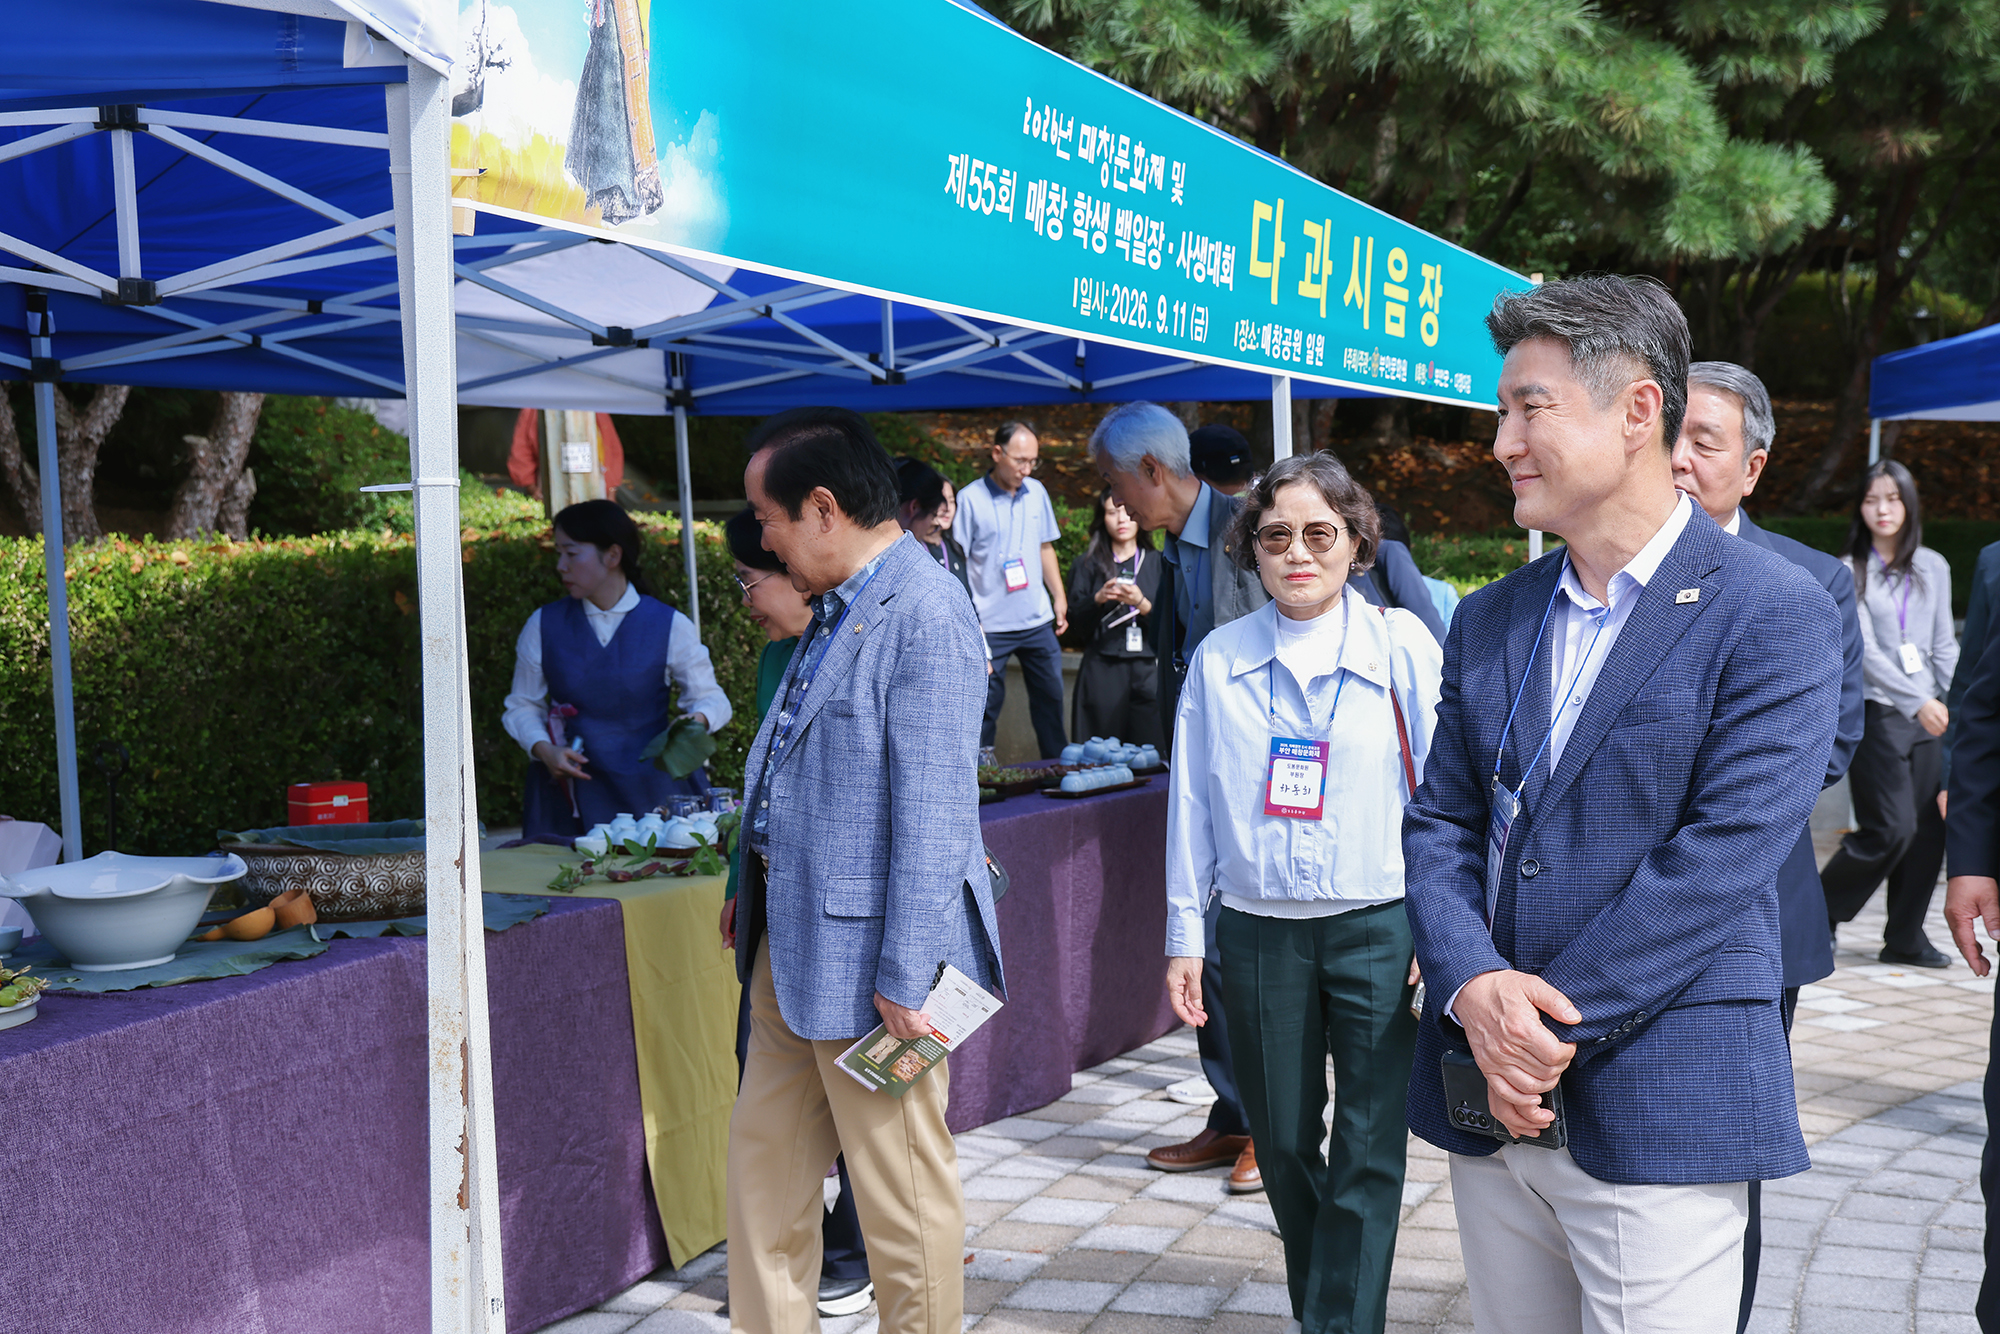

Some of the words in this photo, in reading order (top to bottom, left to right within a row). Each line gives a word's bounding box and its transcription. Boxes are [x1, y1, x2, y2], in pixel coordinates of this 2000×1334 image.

[1023, 96, 1075, 161] 2026년
[1078, 123, 1165, 194] 매창문화제
[1170, 160, 1186, 206] 및
[944, 153, 1018, 223] 제55회
[1024, 179, 1068, 241] 매창
[1072, 191, 1111, 255] 학생
[1305, 332, 1326, 367] 일원
[1279, 747, 1291, 755] 부안
[1291, 748, 1320, 758] 매창문화제
